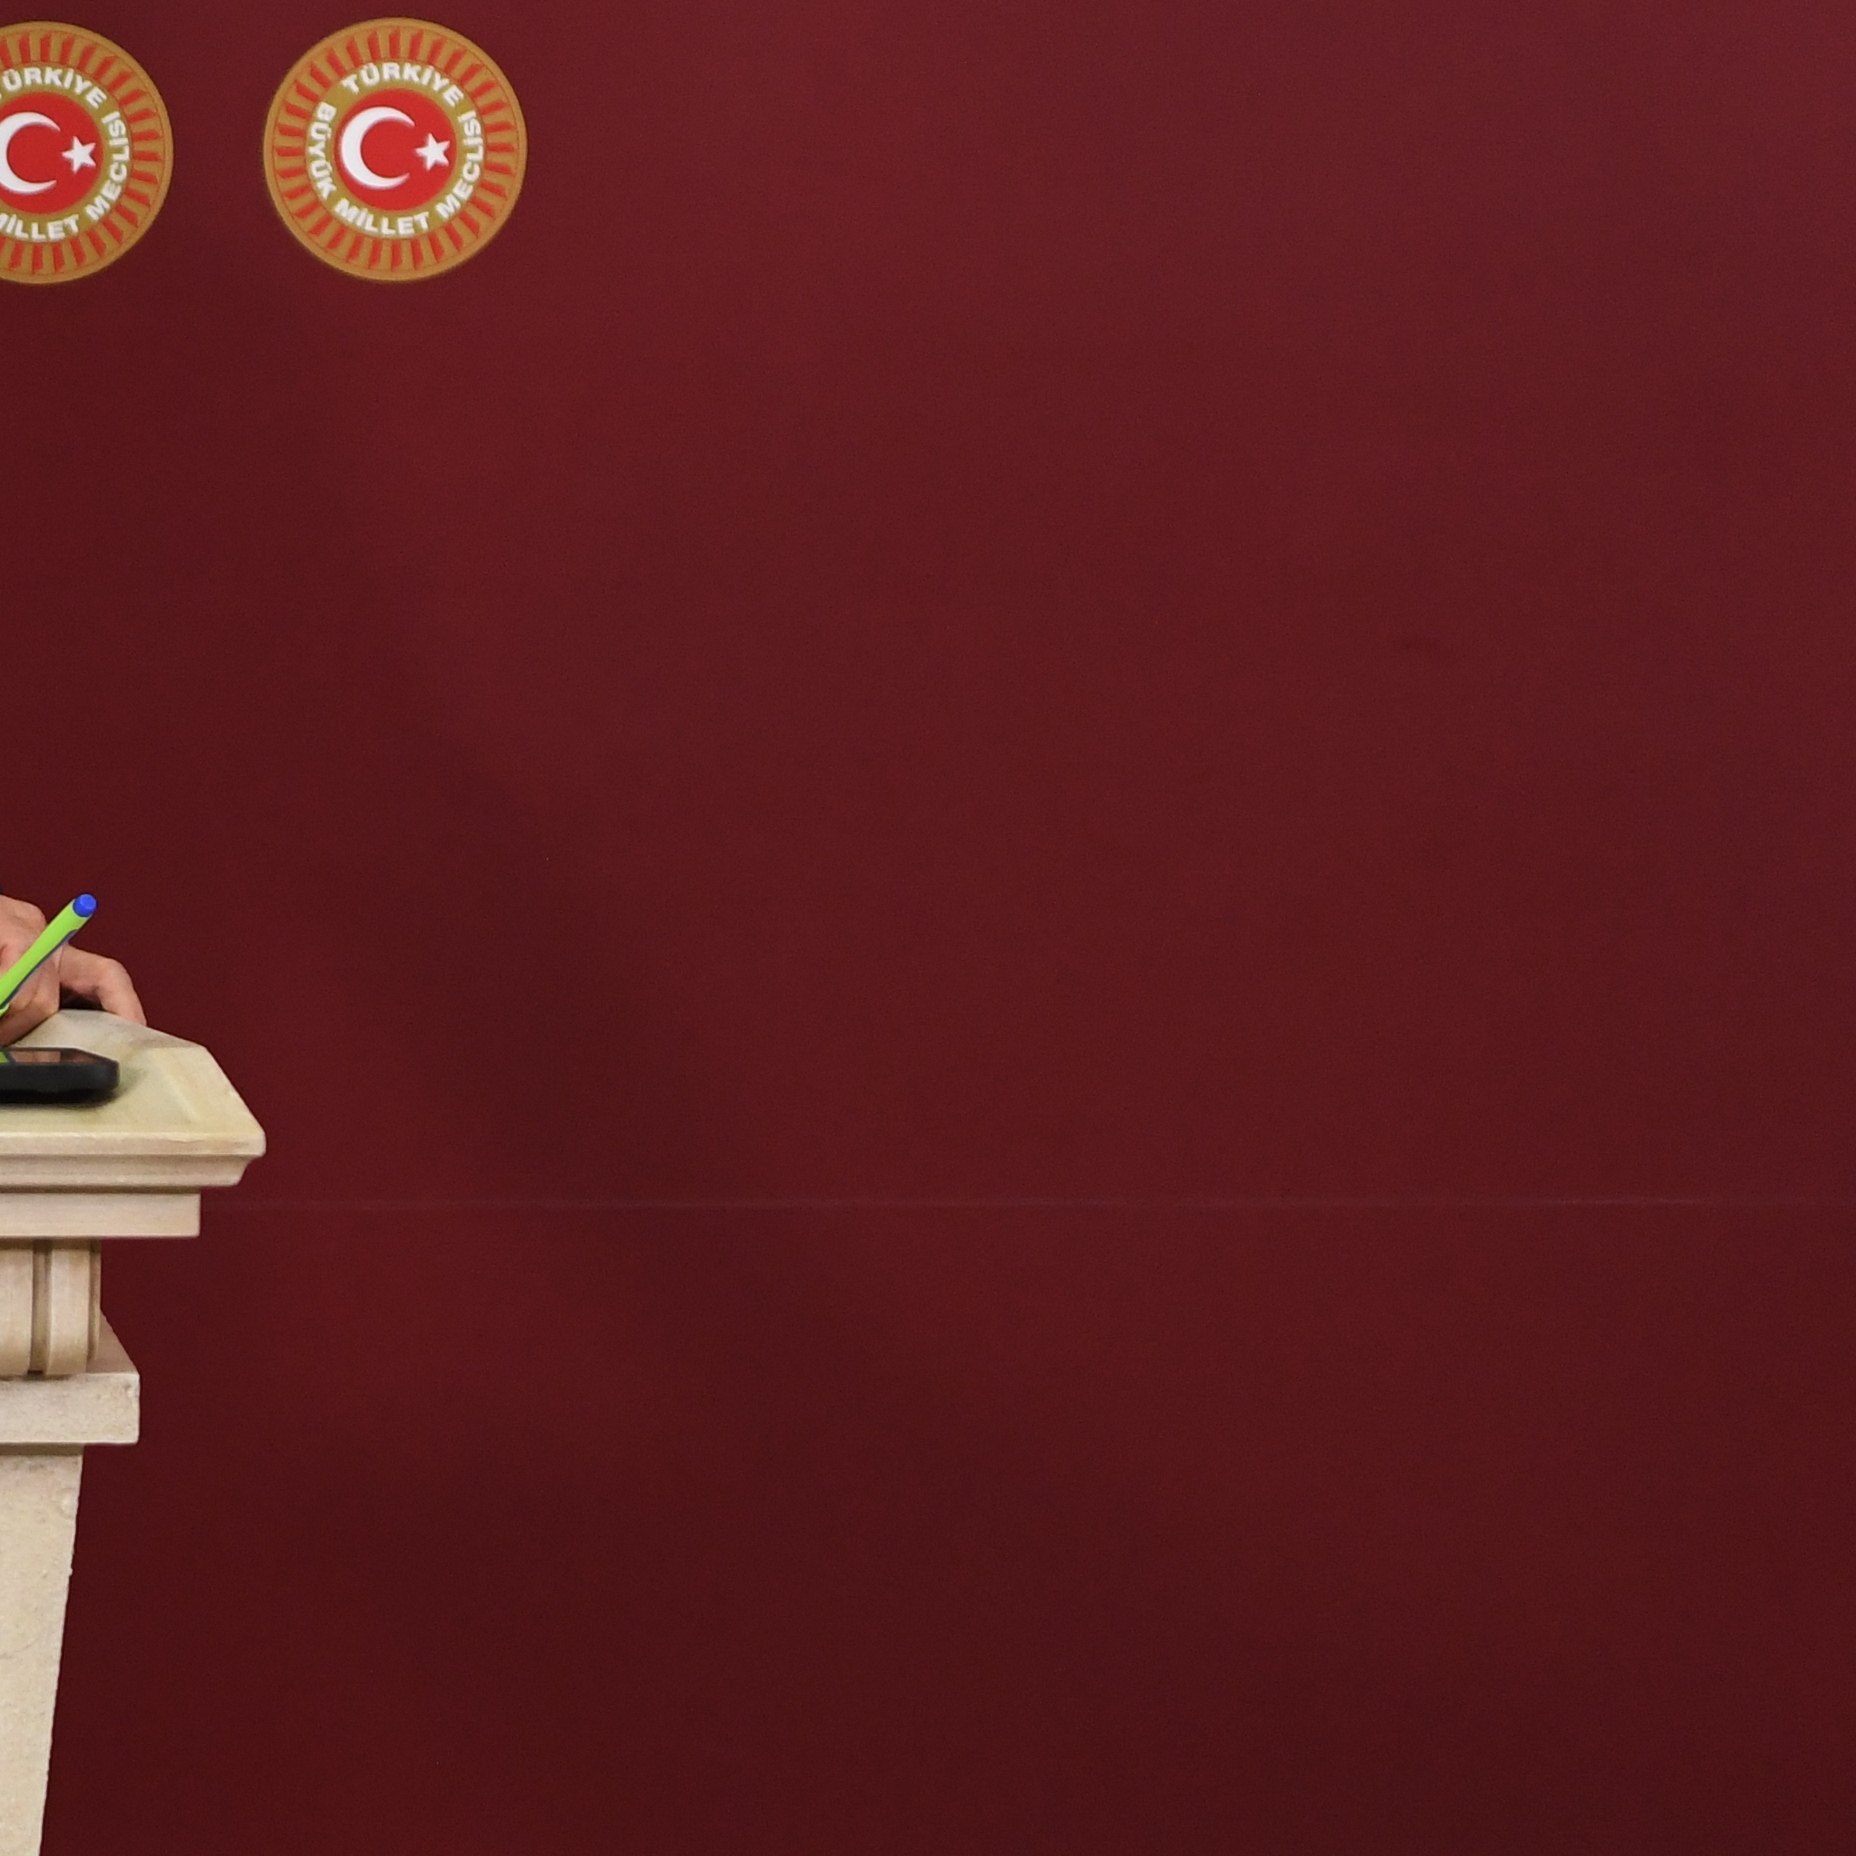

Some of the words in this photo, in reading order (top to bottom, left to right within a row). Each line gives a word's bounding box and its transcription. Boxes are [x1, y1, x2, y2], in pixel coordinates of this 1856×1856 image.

[341, 62, 465, 108] TÜRKİYE
[84, 110, 130, 221] MECLİSİ
[307, 101, 338, 200] BÜYÜK
[434, 110, 484, 220] MECLİSİ
[333, 197, 431, 238] MİLLET
